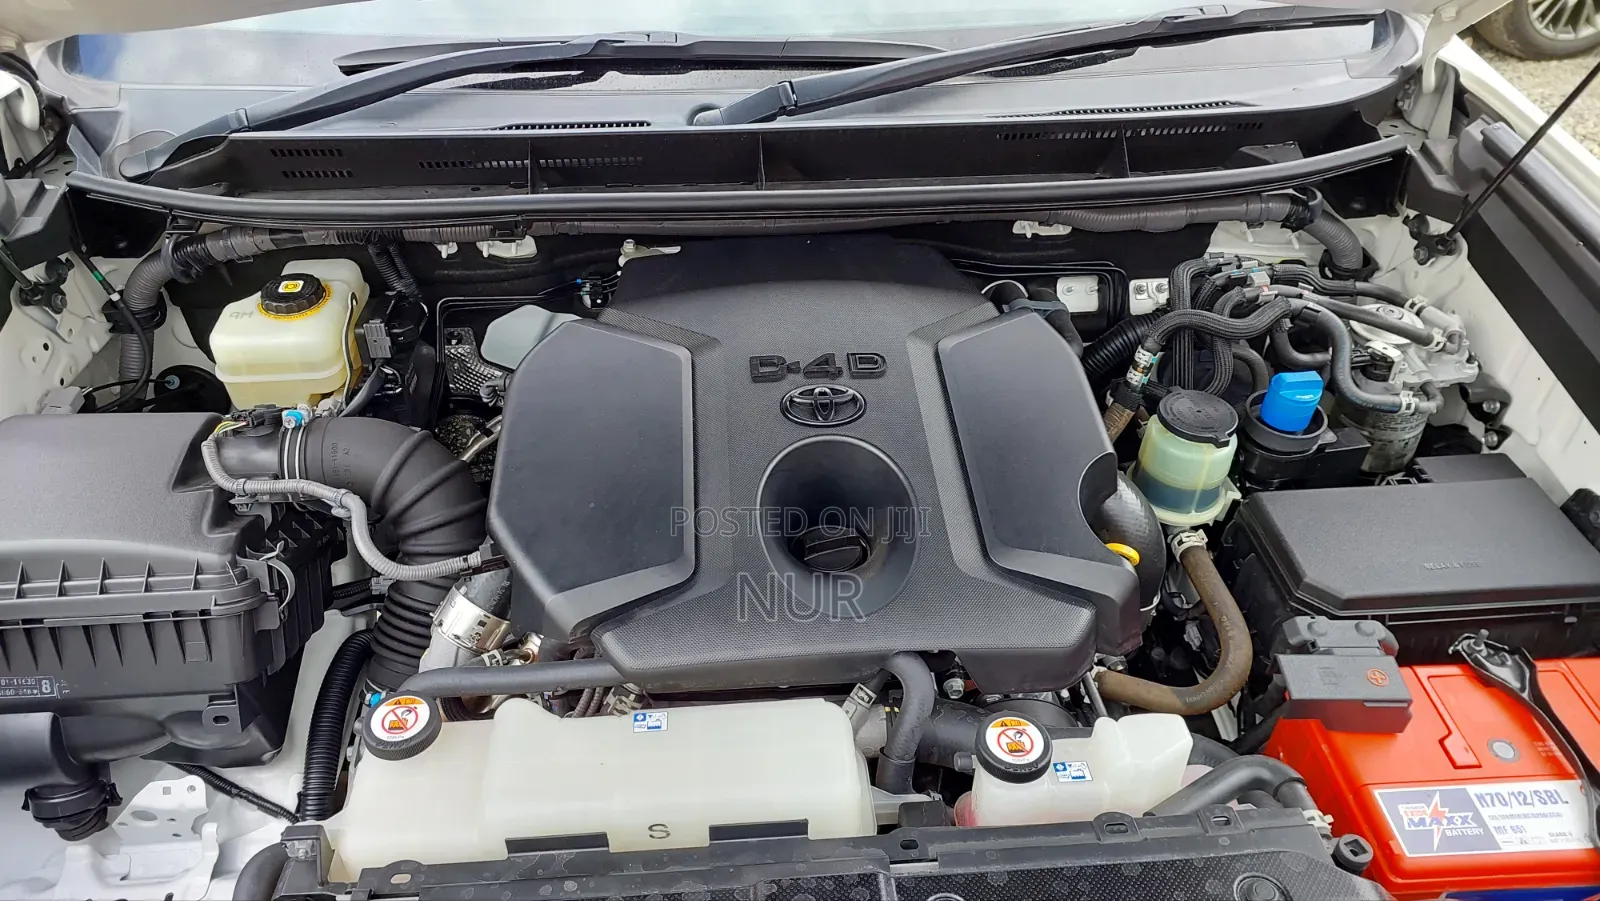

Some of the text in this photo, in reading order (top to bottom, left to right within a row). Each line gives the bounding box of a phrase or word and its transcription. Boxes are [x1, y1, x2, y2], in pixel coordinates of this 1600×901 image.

[1474, 788, 1569, 809] N70/12/SBL
[1407, 815, 1470, 828] MAXX
[647, 823, 671, 840] S
[1444, 827, 1484, 837] BATTERY
